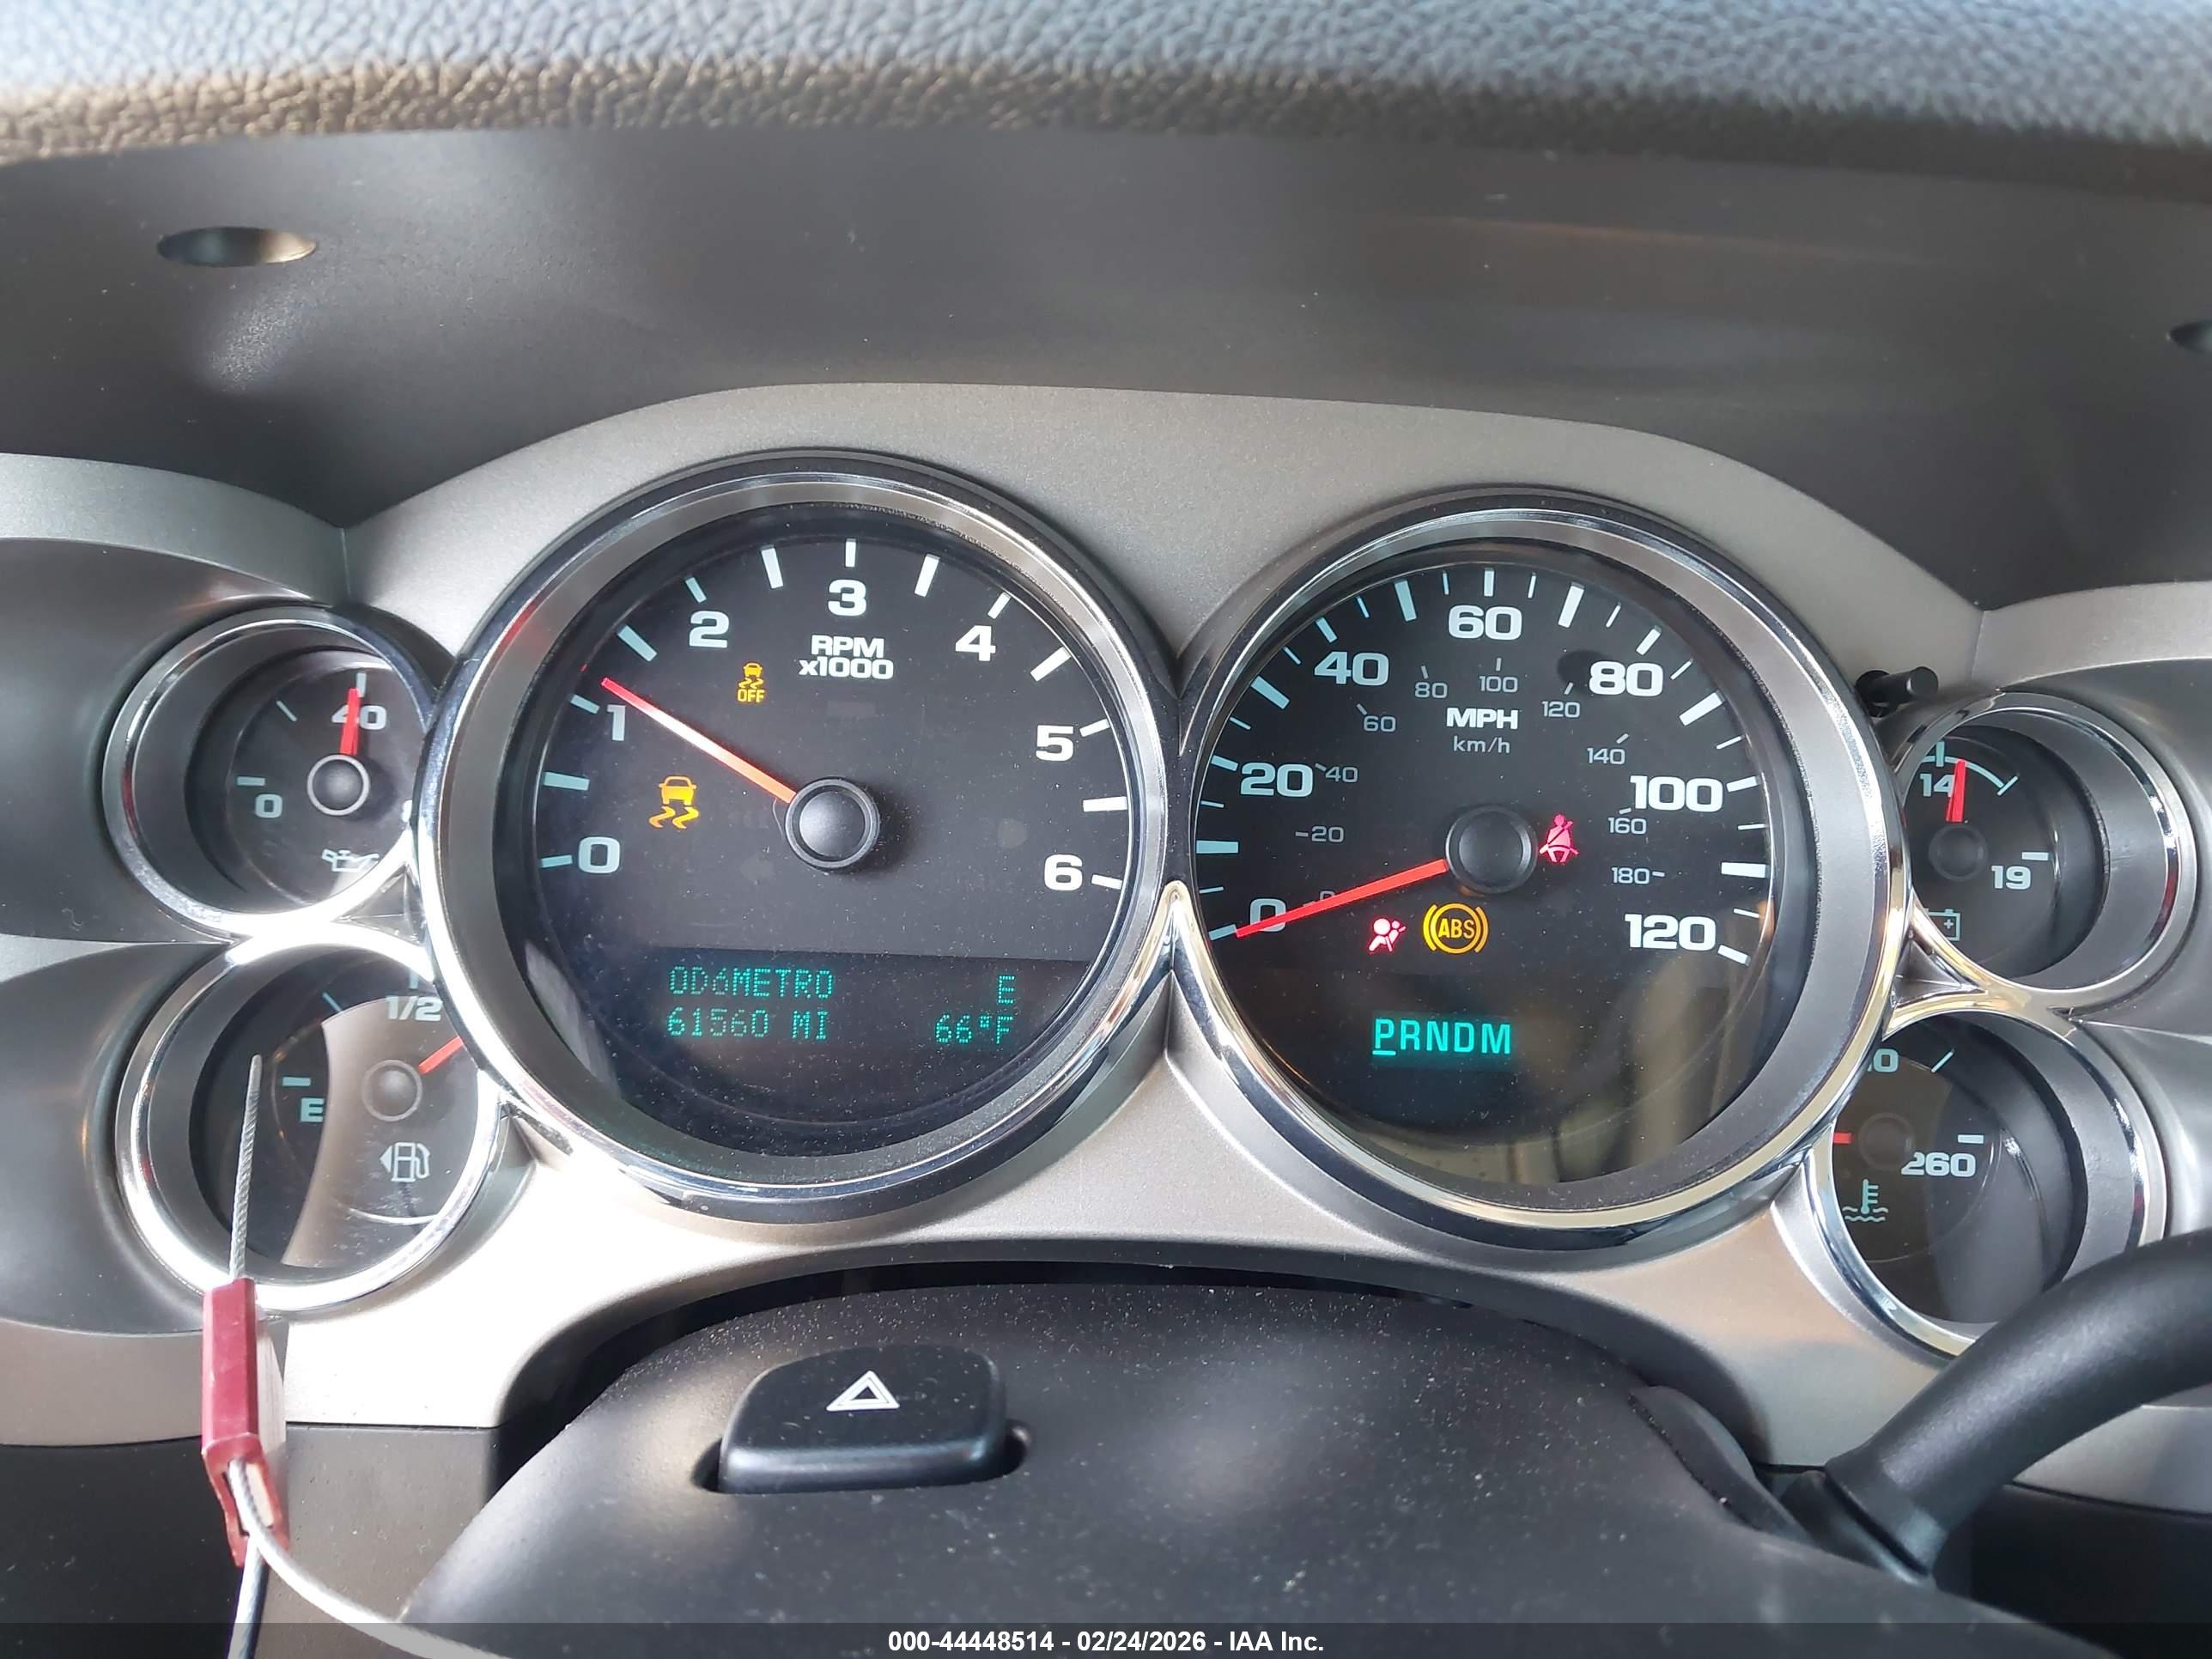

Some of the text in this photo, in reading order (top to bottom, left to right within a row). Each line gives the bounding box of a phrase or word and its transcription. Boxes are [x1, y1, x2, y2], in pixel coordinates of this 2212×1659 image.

[828, 579, 867, 617] 3
[689, 611, 729, 649] 2
[1449, 605, 1522, 641] 60
[811, 635, 884, 659] RPM
[955, 626, 997, 661] 4
[799, 657, 894, 679] x1000
[1314, 651, 1389, 686] 40
[1589, 660, 1663, 696] 80
[737, 689, 764, 703] OFF
[1414, 682, 1448, 699] 80
[1480, 676, 1518, 693] 100
[331, 704, 386, 730] 40
[1446, 708, 1518, 729] MPH
[1542, 701, 1581, 718] 120
[607, 705, 625, 741] 1
[1363, 715, 1396, 732] 60
[1036, 726, 1075, 762] 5
[1453, 736, 1510, 754] km/h
[1587, 748, 1626, 765] 140
[1240, 762, 1314, 797] 20
[1326, 766, 1358, 783] 40
[1919, 773, 1954, 797] 14
[255, 793, 283, 818] 0
[1630, 775, 1723, 812] 100
[1311, 826, 1345, 843] 20
[1607, 817, 1647, 835] 160
[578, 836, 620, 874] 0
[1044, 854, 1083, 891] 6
[1612, 867, 1650, 884] 180
[1991, 865, 2032, 890] 19
[1250, 898, 1286, 932] 0
[1437, 918, 1475, 939] ABS
[1624, 914, 1717, 951] 120
[997, 975, 1016, 1005] E
[386, 994, 443, 1021] 1/2
[667, 1007, 830, 1040] 61560 MI
[935, 1014, 1014, 1044] 66°F
[1373, 1018, 1511, 1055] PRNDM
[301, 1097, 325, 1122] E
[1901, 1152, 1976, 1177] 260
